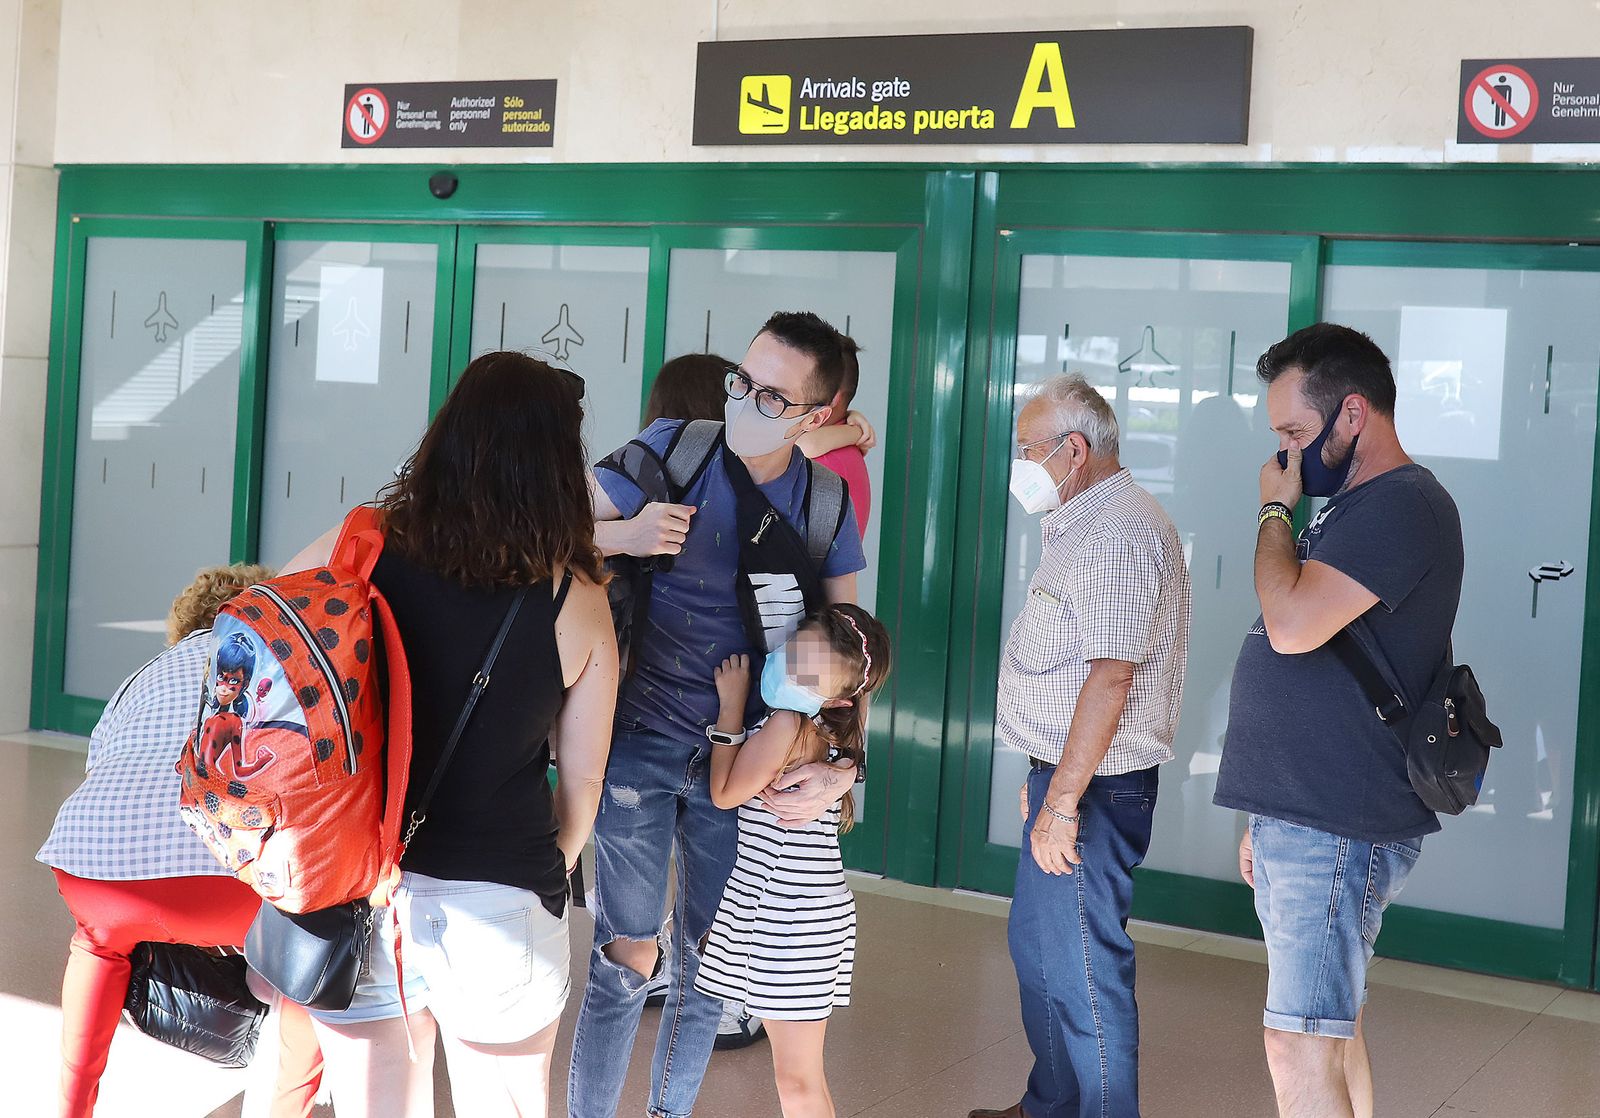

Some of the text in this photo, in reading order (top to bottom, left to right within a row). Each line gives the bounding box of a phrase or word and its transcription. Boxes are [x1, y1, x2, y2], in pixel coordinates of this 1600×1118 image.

[800, 77, 910, 101] Arrivals gate
[1010, 42, 1076, 129] A
[1553, 82, 1575, 93] Nur
[397, 101, 410, 110] Nur
[451, 97, 495, 108] Authorized
[504, 96, 524, 108] Sólo
[1552, 94, 1600, 106] Personal
[396, 110, 437, 120] Personal mit
[449, 109, 490, 120] personnel
[503, 109, 541, 121] personal
[799, 105, 994, 136] Llegadas puerta
[395, 119, 441, 130] Genehmigung
[449, 121, 468, 133] only
[502, 121, 550, 133] autorizado
